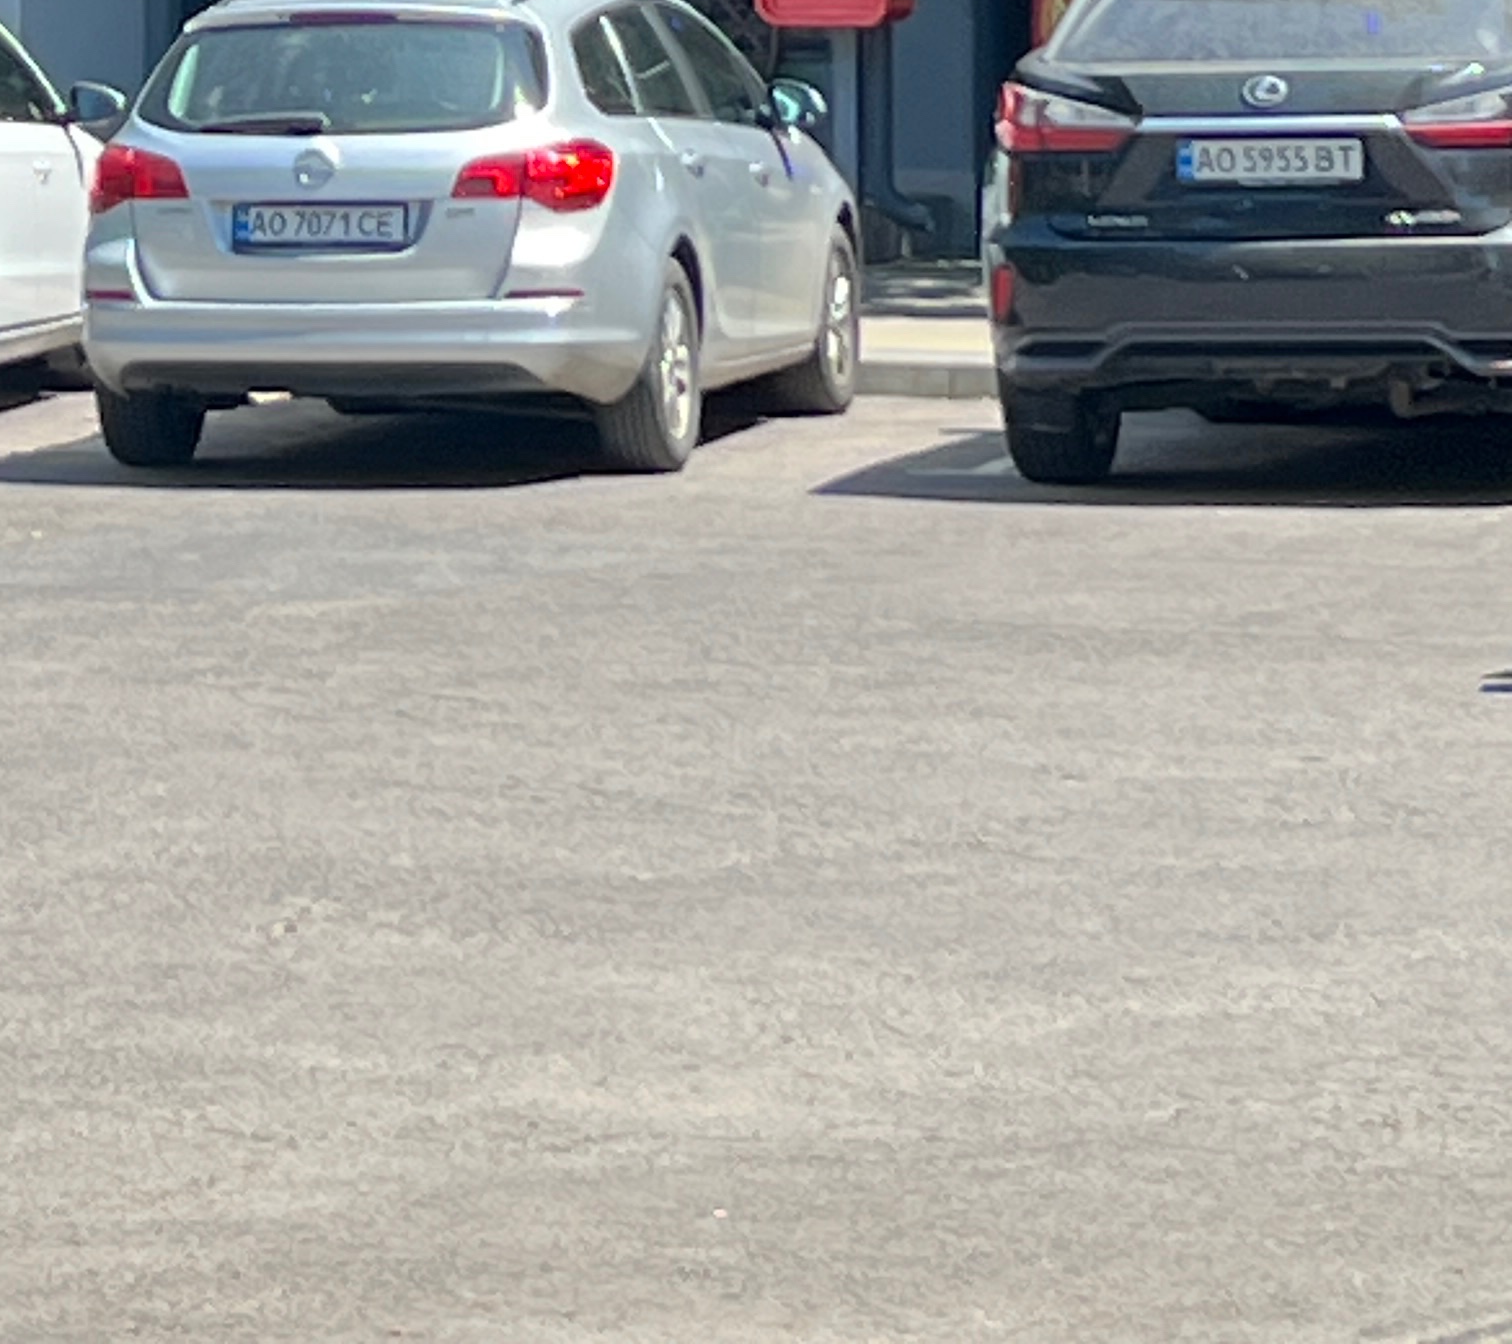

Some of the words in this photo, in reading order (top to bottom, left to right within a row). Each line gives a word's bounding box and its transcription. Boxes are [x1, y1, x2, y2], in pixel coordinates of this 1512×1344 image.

[1196, 146, 1236, 173] AO
[1242, 145, 1309, 173] 5955
[1314, 145, 1355, 173] BT
[251, 210, 287, 237] AO
[293, 210, 351, 238] 7071
[357, 210, 394, 238] CE
